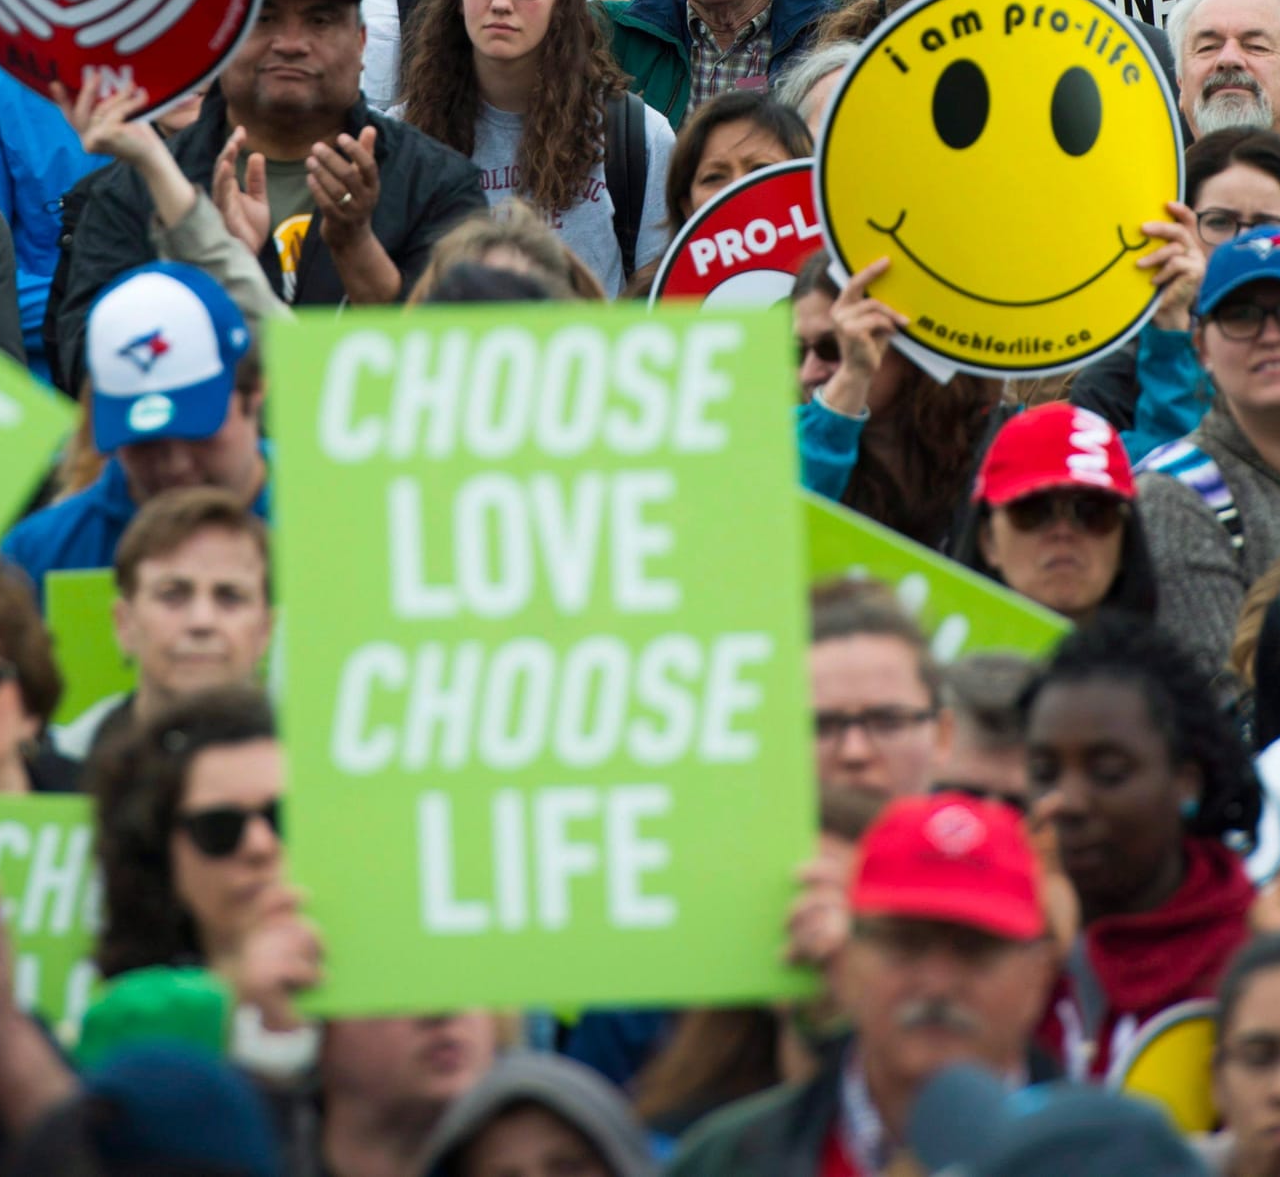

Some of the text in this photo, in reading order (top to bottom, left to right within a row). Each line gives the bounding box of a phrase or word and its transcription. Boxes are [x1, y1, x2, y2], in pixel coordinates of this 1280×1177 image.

[884, 2, 1142, 88] i am pro-life
[319, 322, 744, 463] CHOOSE
[915, 313, 1093, 358] marchforlife.ca
[387, 470, 681, 621] LOVE
[330, 632, 775, 775] CHOOSE
[417, 784, 680, 937] LIFE
